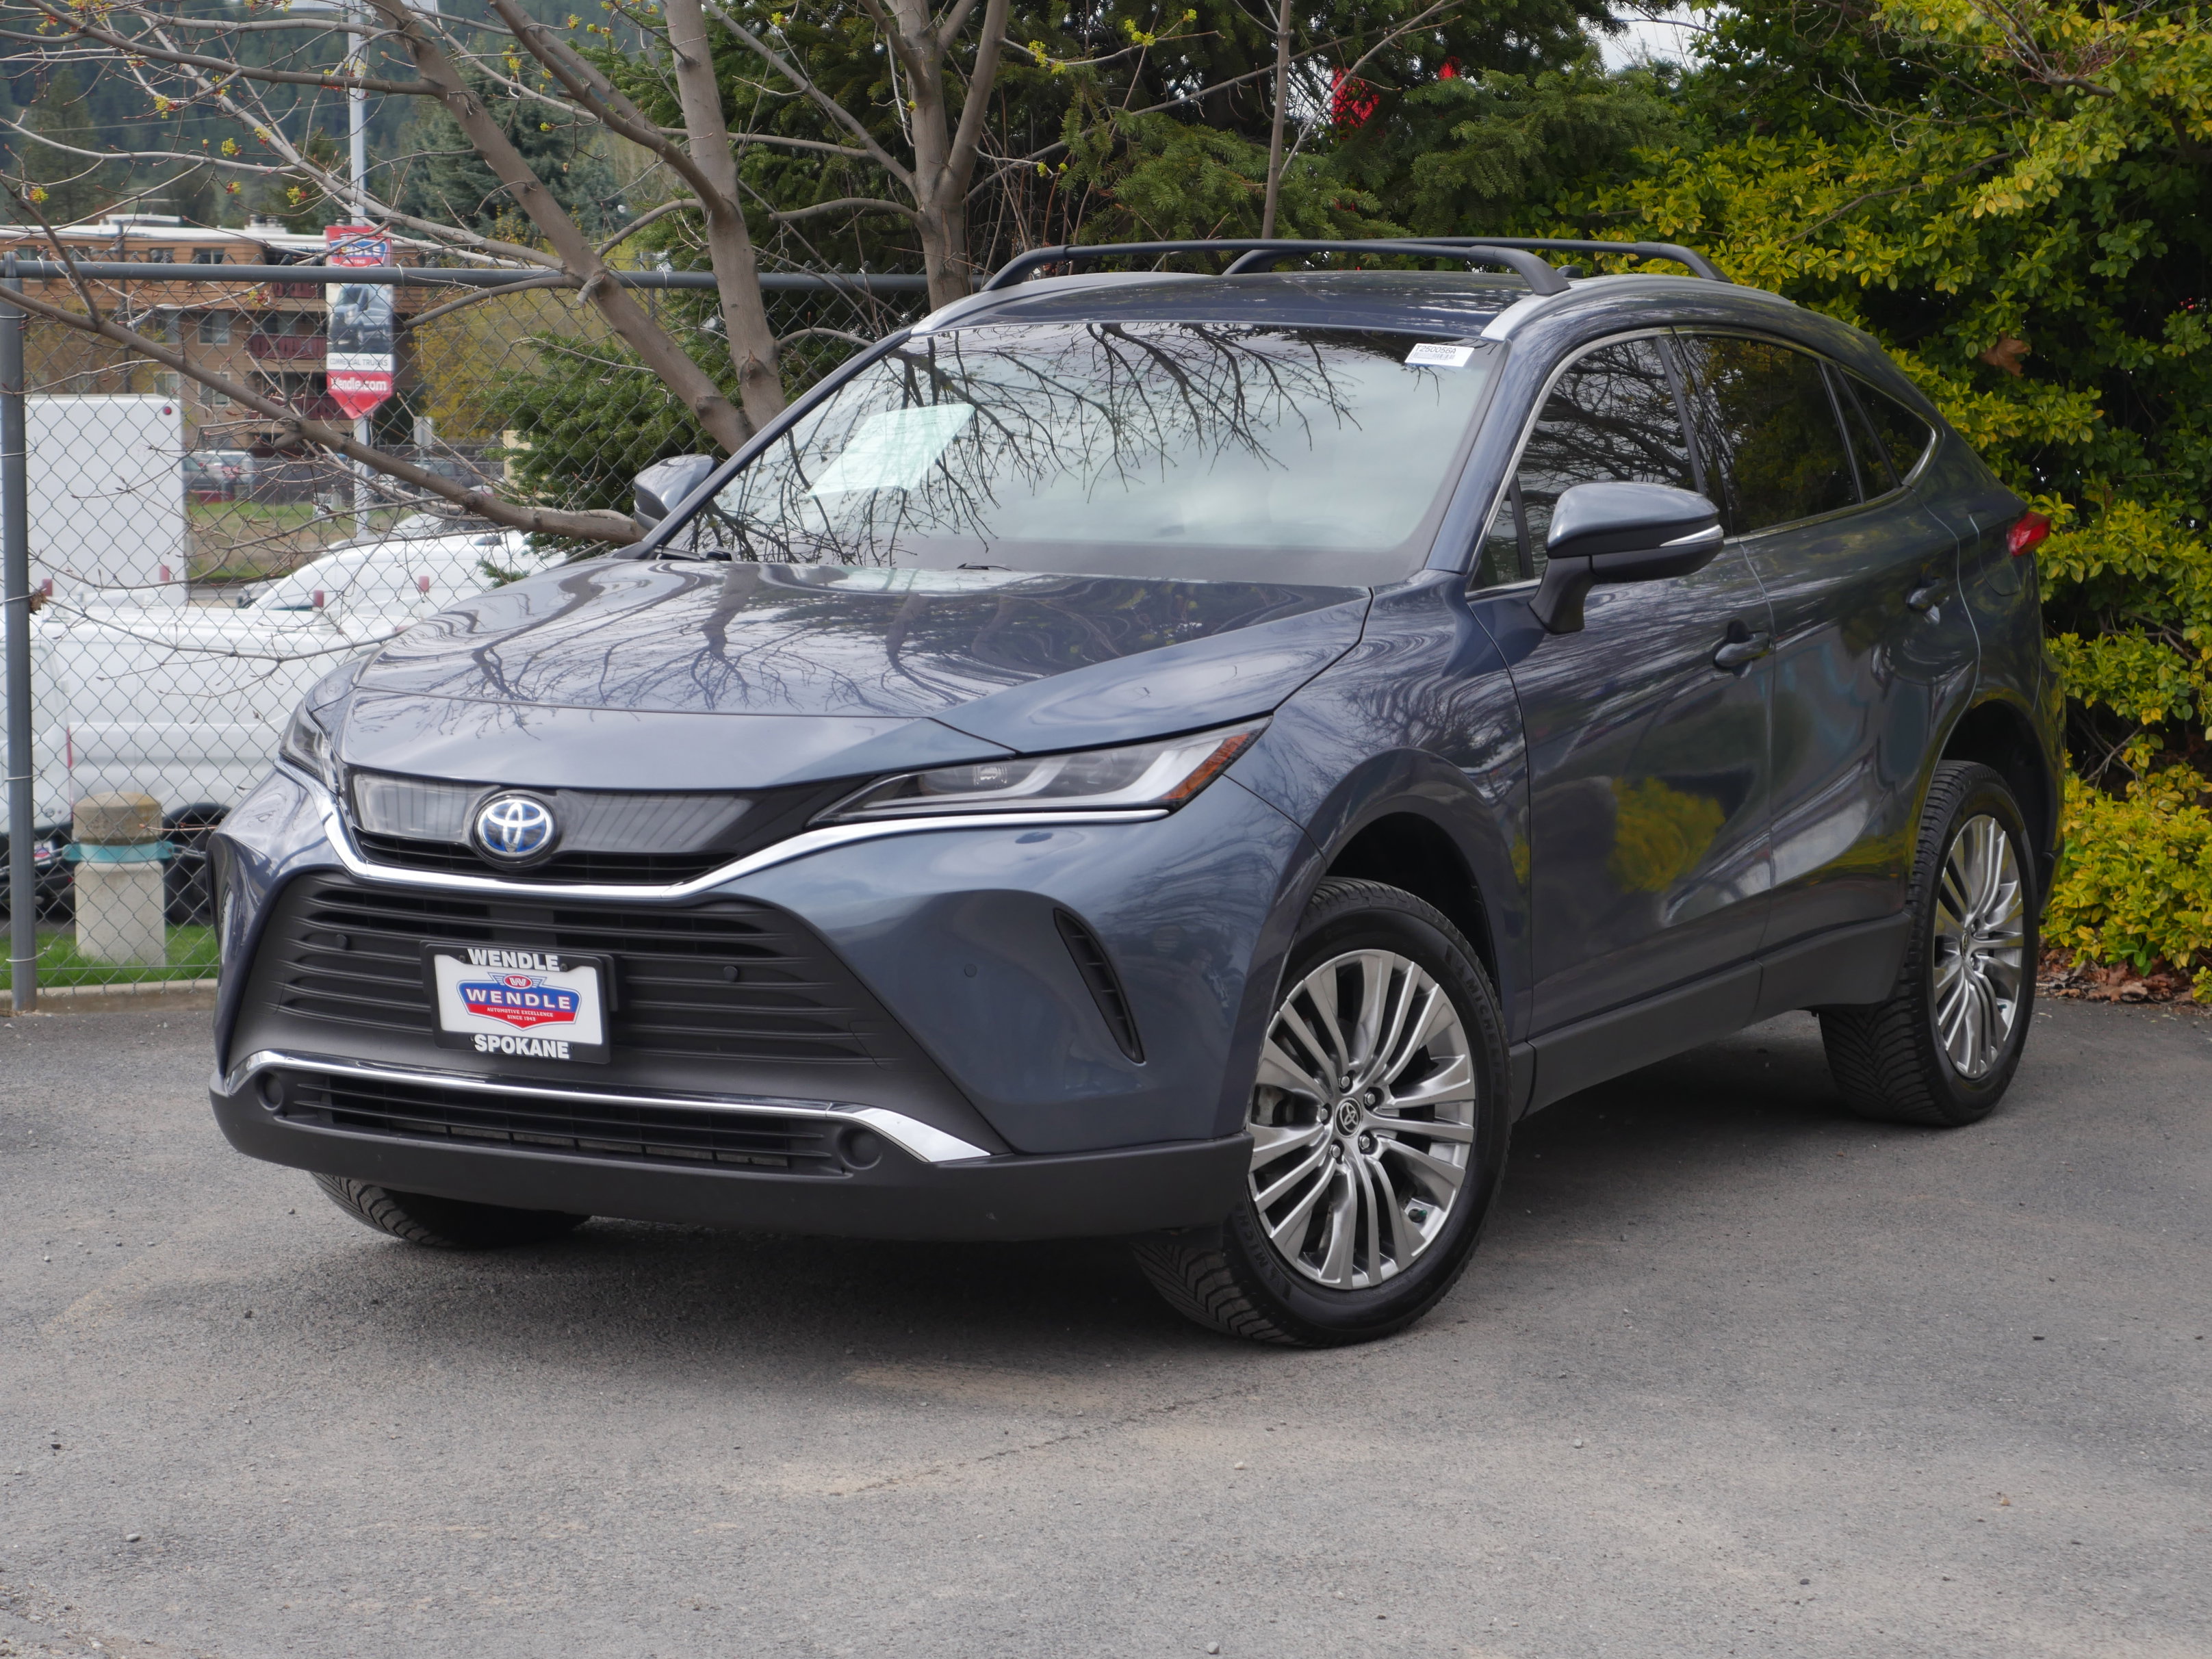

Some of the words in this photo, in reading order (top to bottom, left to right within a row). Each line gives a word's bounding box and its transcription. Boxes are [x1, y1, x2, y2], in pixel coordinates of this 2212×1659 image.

[1415, 345, 1456, 354] T250056A
[331, 376, 387, 391] Wendle.com
[467, 949, 560, 971] WENDLE
[466, 988, 570, 1009] WENDLE
[487, 1007, 520, 1015] AUTOMOTIVE
[474, 1034, 569, 1059] SPOKANE
